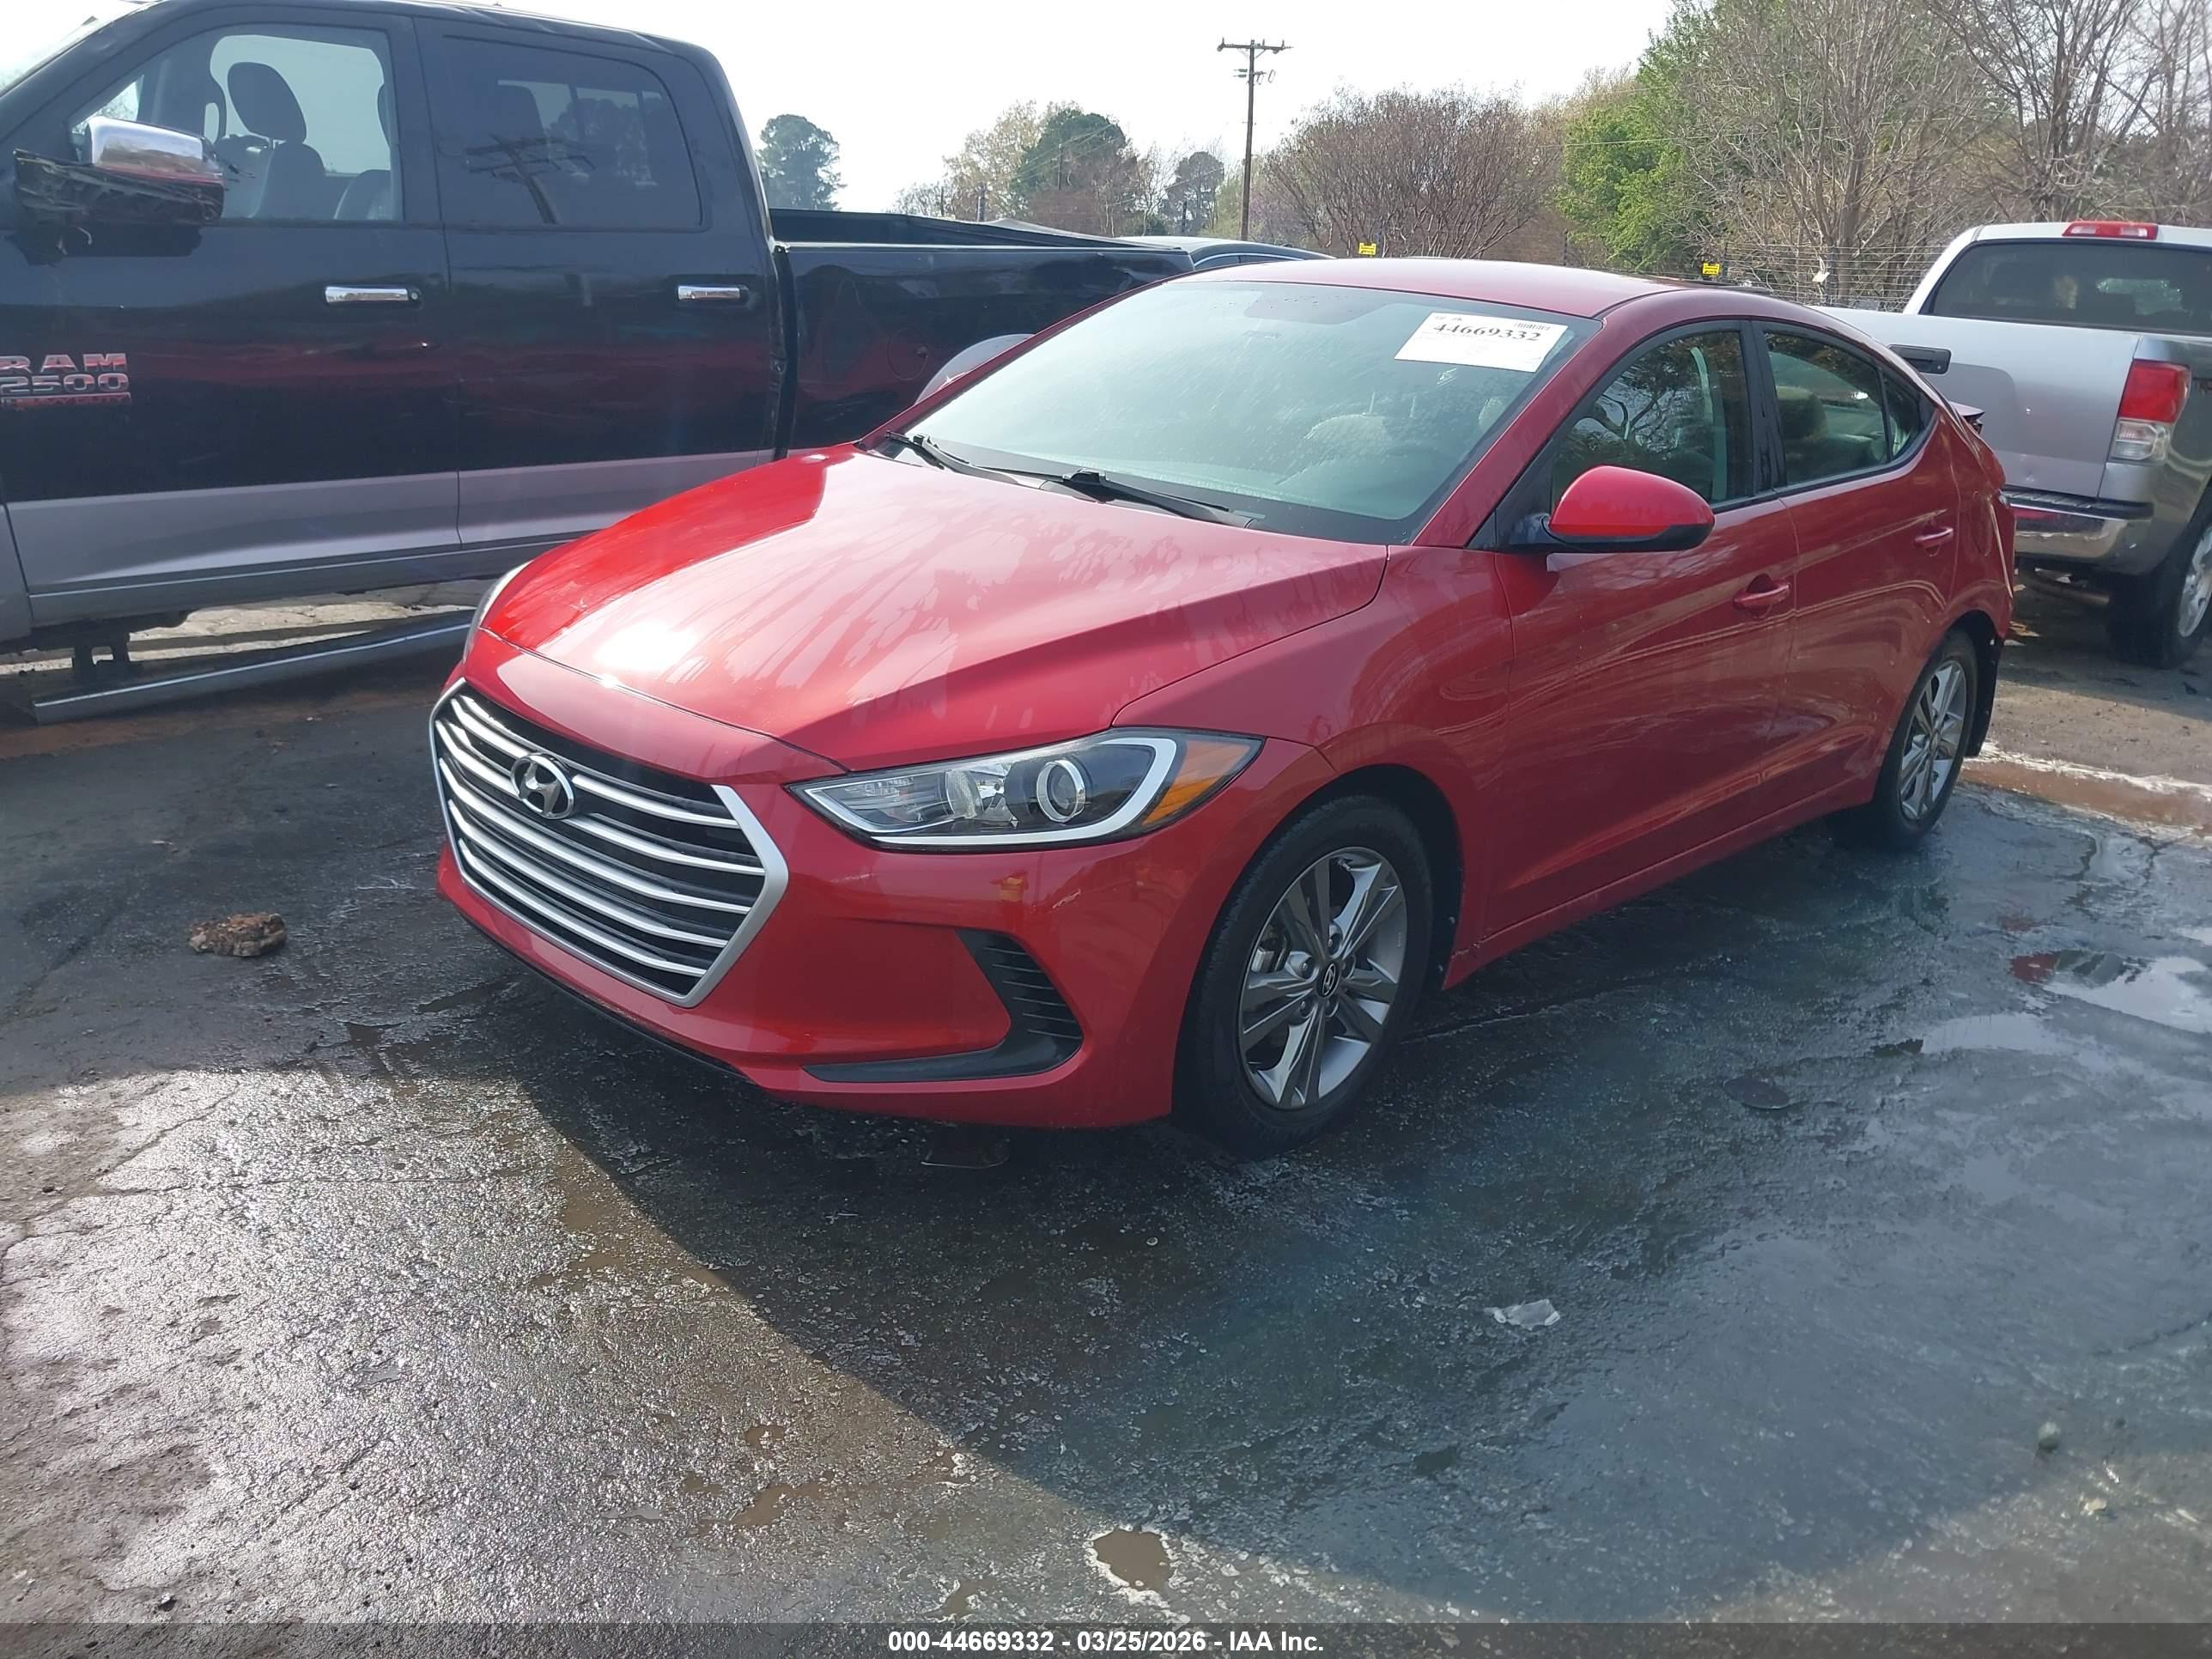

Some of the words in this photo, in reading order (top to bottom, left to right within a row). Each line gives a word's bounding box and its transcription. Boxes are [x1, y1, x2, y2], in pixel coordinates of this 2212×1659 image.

[1432, 323, 1542, 342] 44669332
[0, 353, 128, 374] RAM
[0, 373, 130, 393] 2500
